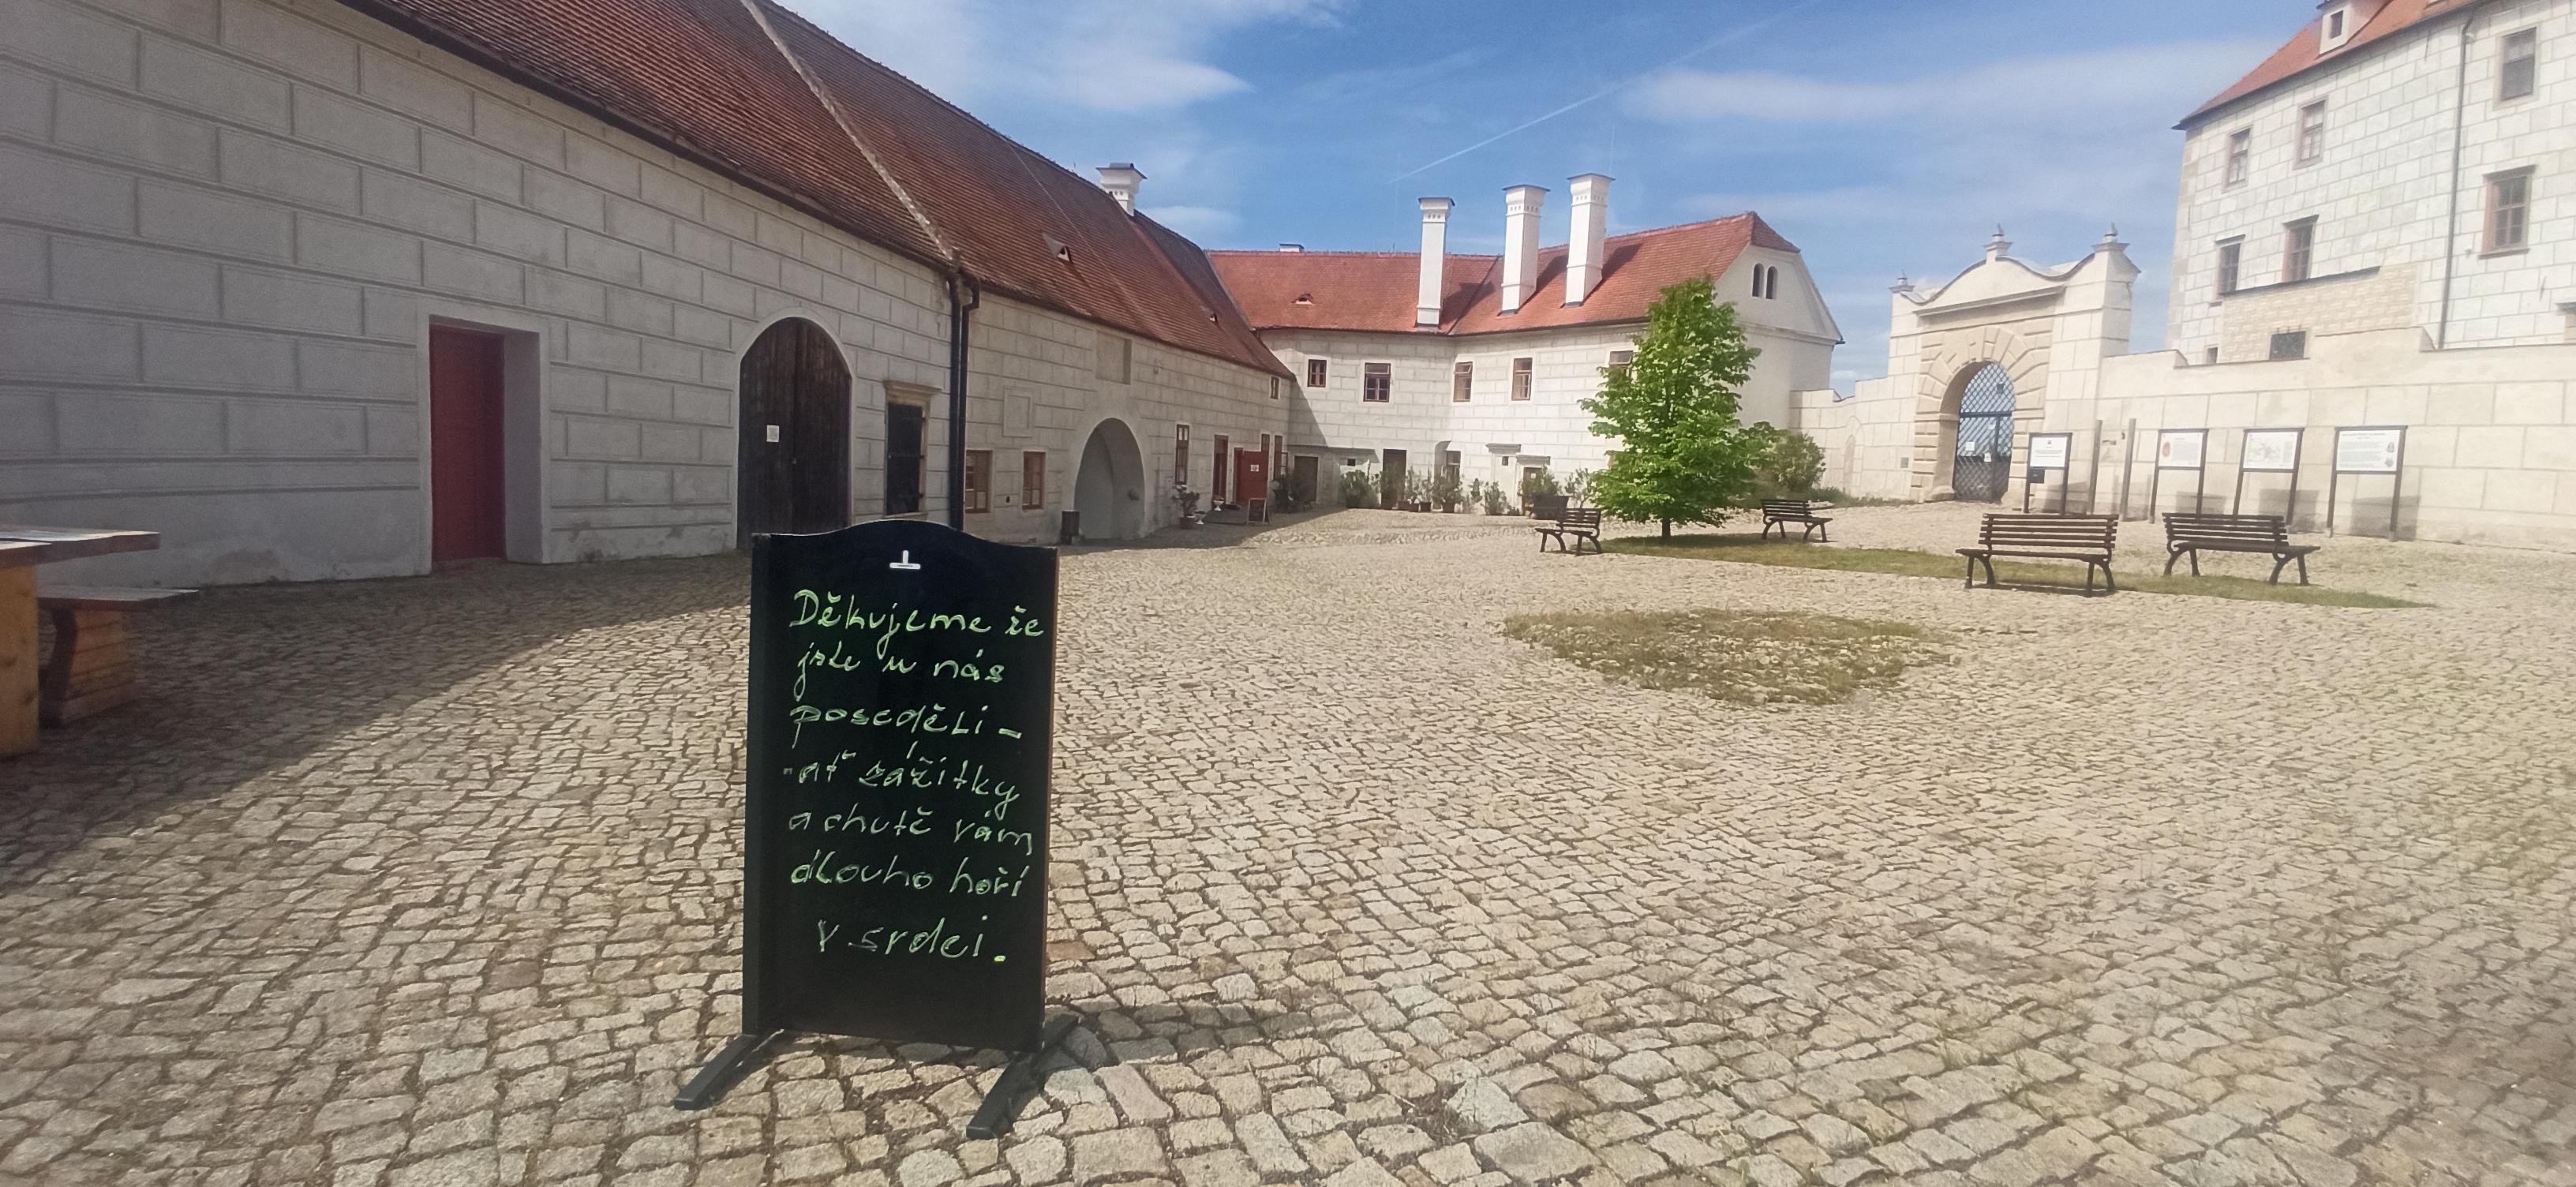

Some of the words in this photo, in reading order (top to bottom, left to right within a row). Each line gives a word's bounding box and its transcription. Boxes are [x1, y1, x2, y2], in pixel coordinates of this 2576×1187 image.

[789, 589, 992, 661] Děkujeme
[792, 641, 861, 702] jste
[882, 654, 919, 674] u
[933, 648, 1005, 683] nás
[789, 811, 812, 832] a
[790, 848, 934, 890] dlouho
[949, 856, 1031, 897] hoří
